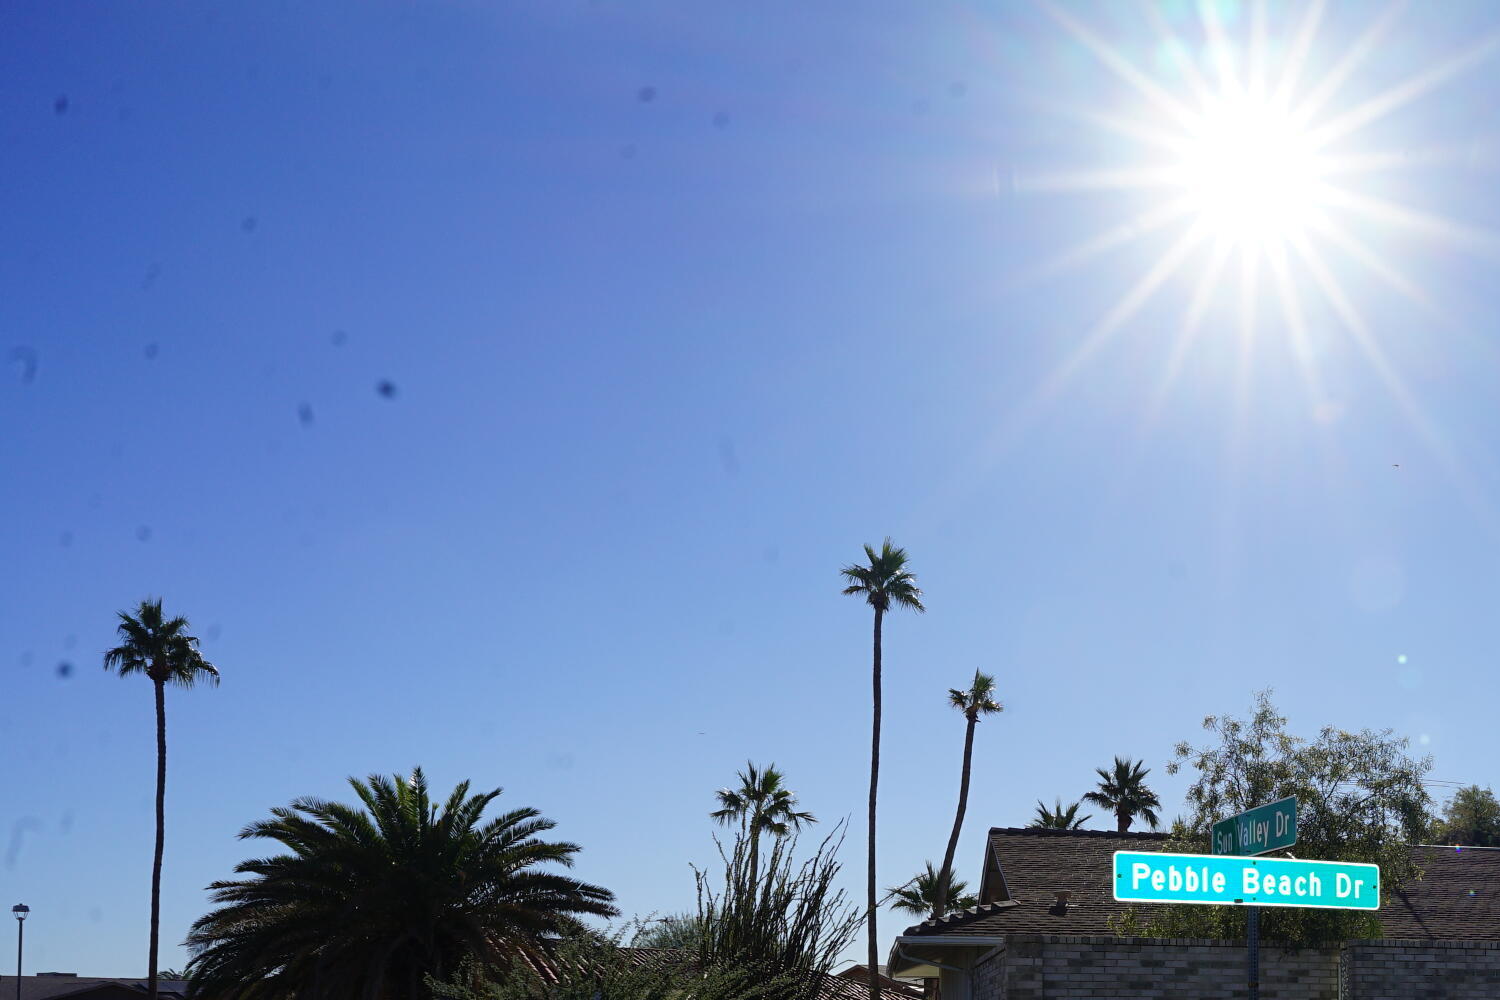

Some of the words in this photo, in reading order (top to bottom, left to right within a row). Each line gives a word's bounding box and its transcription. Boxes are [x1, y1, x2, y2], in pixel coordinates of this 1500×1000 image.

[1217, 831, 1233, 854] Sun
[1237, 819, 1270, 847] Valley
[1276, 811, 1290, 837] Dr
[1132, 863, 1226, 892] Pebble
[1243, 868, 1321, 896] Beach
[1336, 873, 1363, 899] Dr
